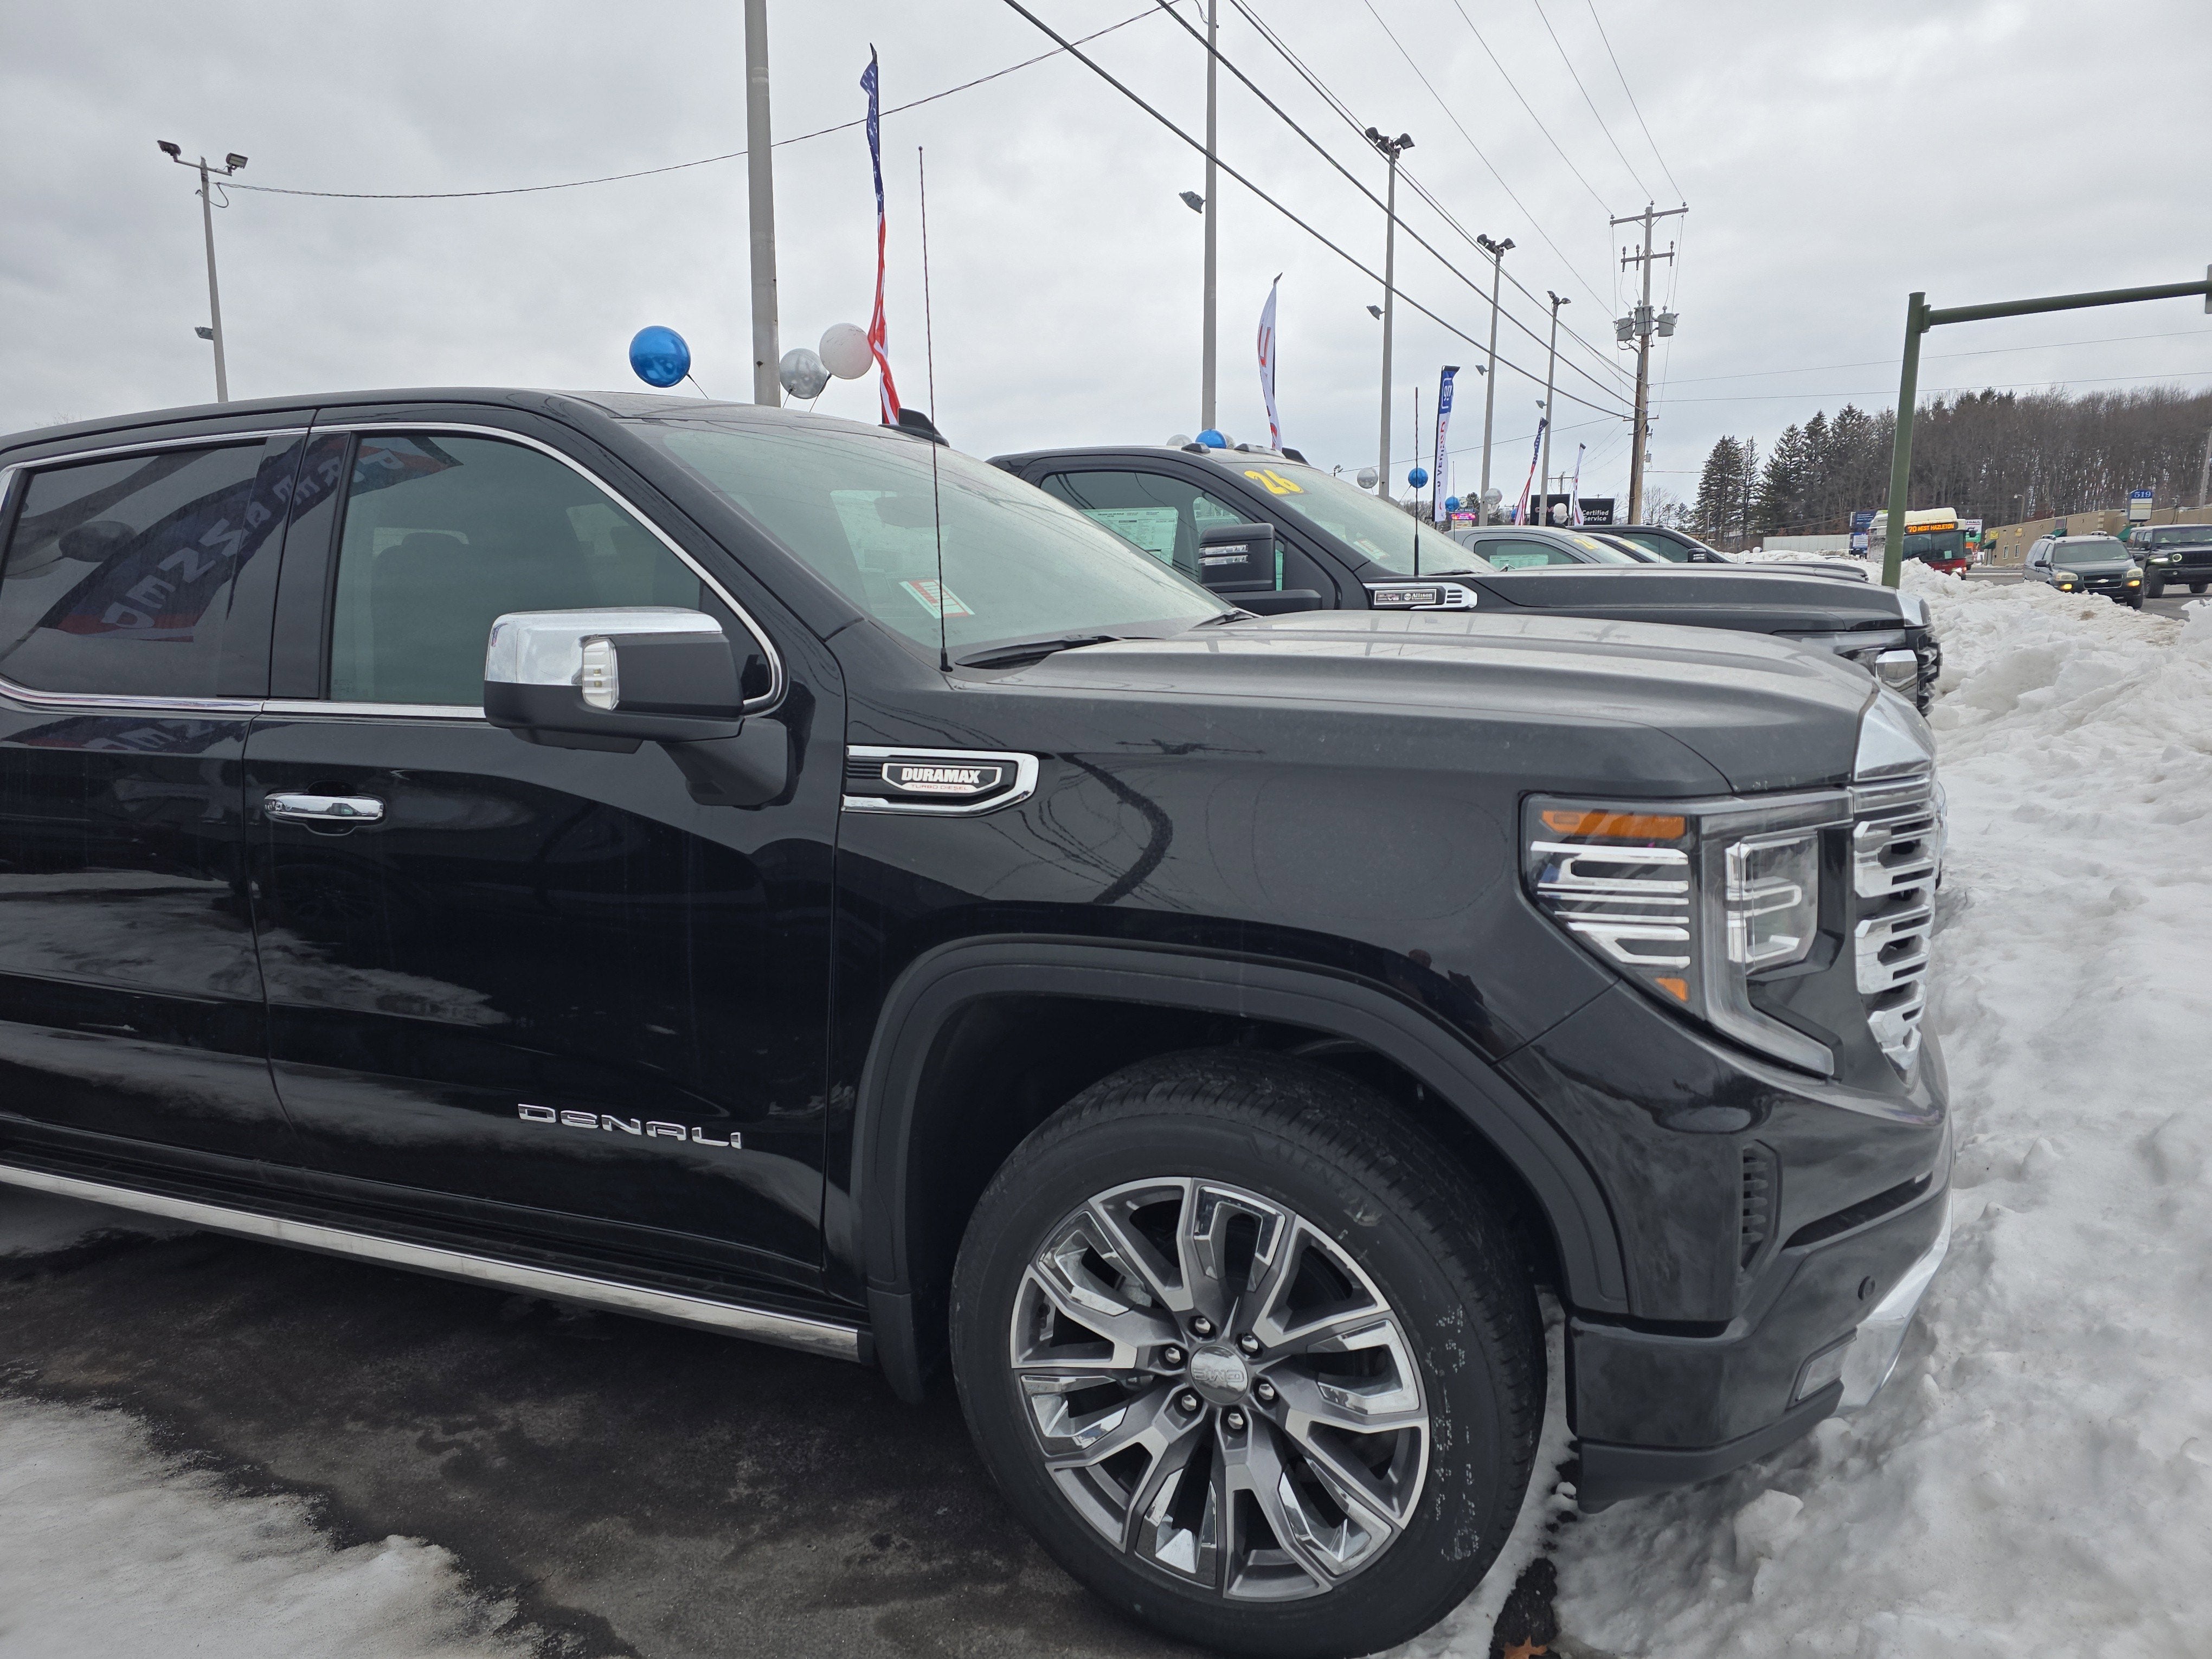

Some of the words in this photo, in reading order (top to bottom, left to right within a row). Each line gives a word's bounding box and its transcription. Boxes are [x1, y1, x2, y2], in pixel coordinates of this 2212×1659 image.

[1244, 469, 1304, 495] 26
[901, 768, 981, 784] DURAMAX
[517, 1103, 743, 1149] DENALI
[1193, 1368, 1245, 1382] GMC
